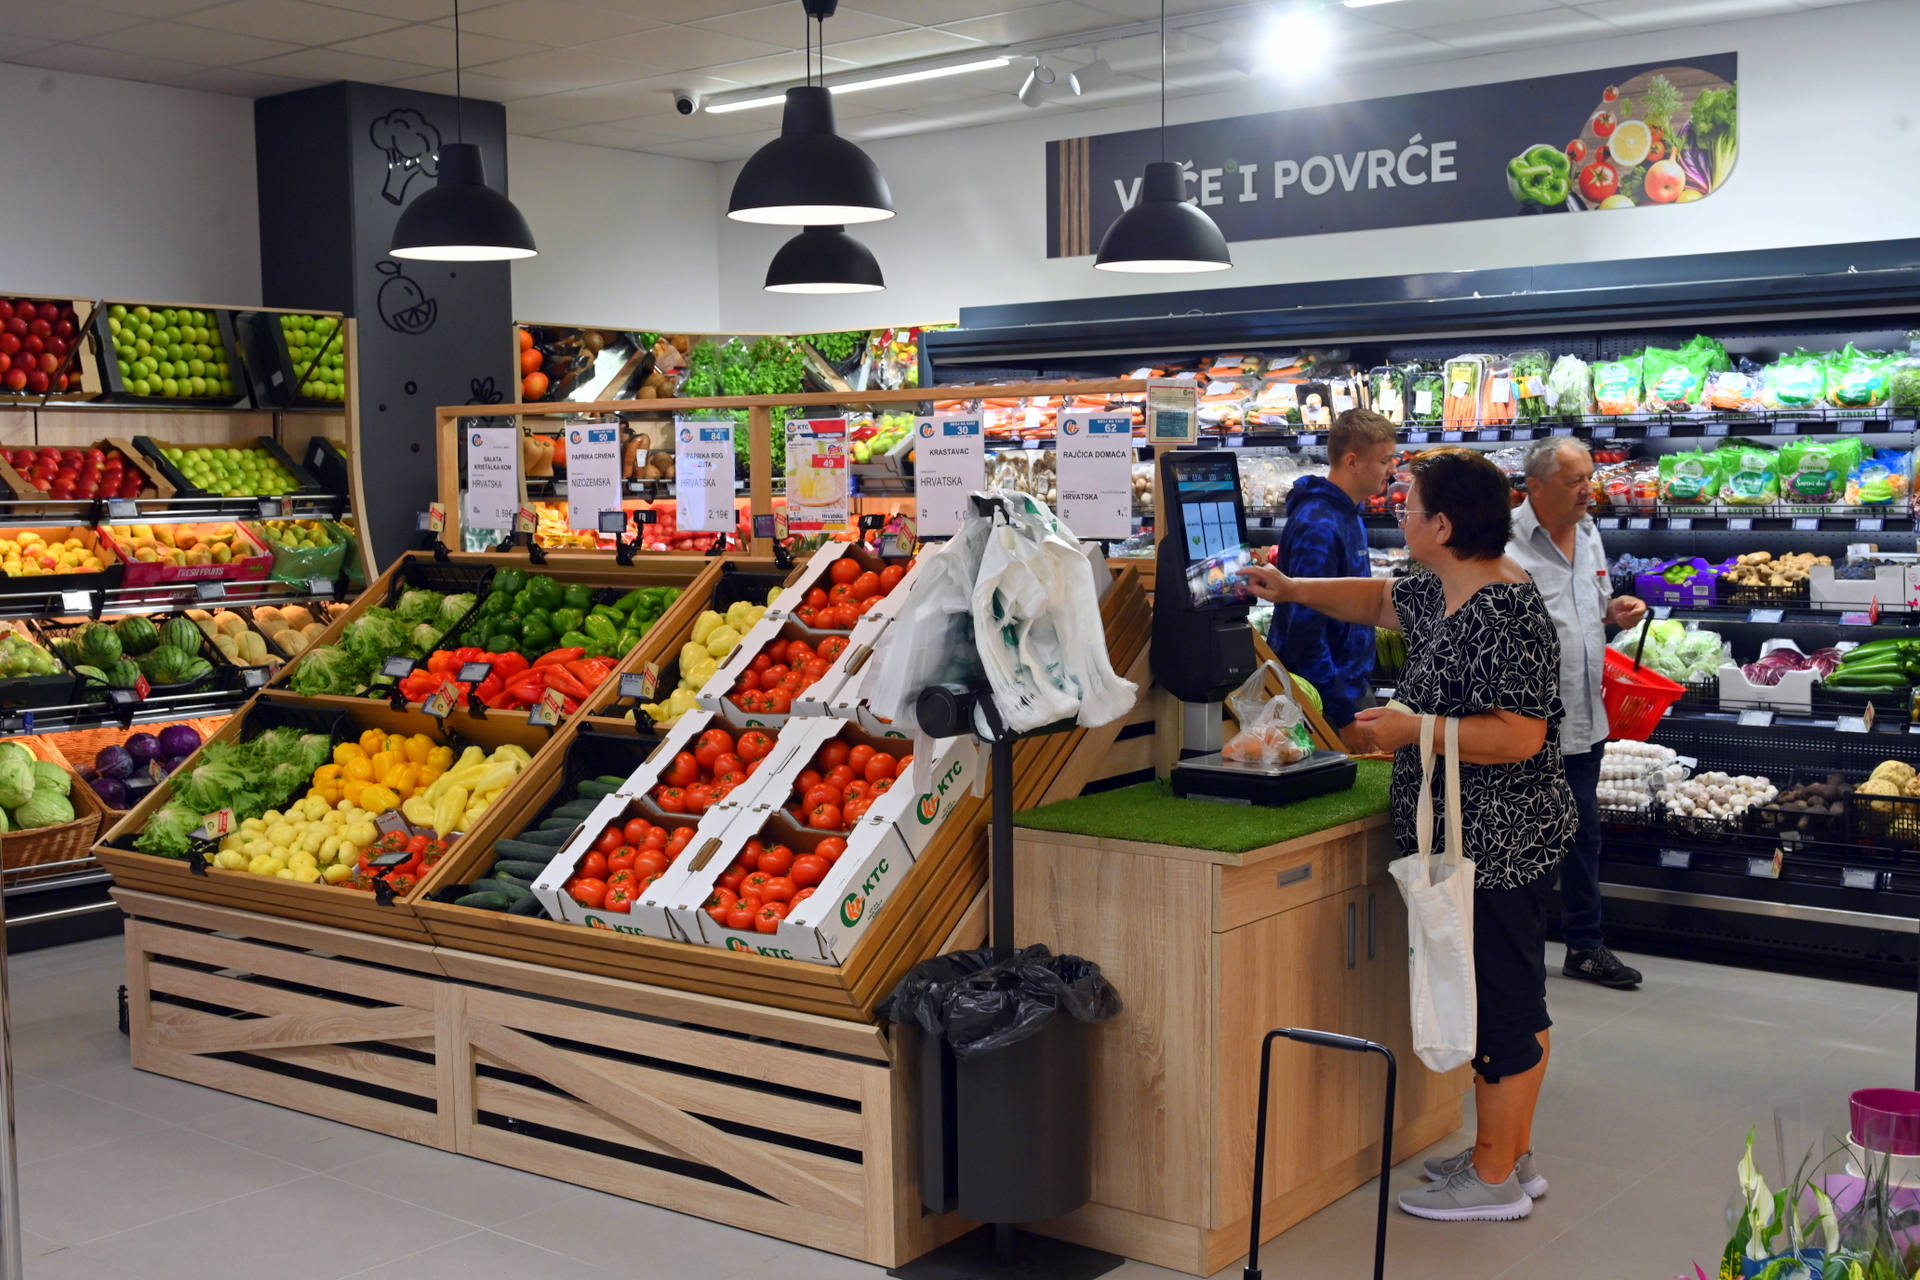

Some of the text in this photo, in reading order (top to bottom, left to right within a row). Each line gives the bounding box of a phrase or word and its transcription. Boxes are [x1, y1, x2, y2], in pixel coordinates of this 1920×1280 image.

[1114, 132, 1457, 212] VĆE I POVRĆE
[957, 426, 968, 435] 30
[1105, 424, 1116, 432] 62
[1063, 449, 1126, 458] RAJČICA DOMAĆA
[472, 480, 502, 488] HRVATSKA
[572, 478, 610, 487] NIZOZEMSKA
[681, 479, 716, 487] HRVATSKA
[920, 477, 962, 486] HRVATSKA
[177, 568, 224, 577] FRESH FRUITS
[938, 760, 962, 796] KTC
[862, 858, 889, 896] KTC
[612, 924, 646, 936] KTC
[756, 946, 793, 960] KTC
